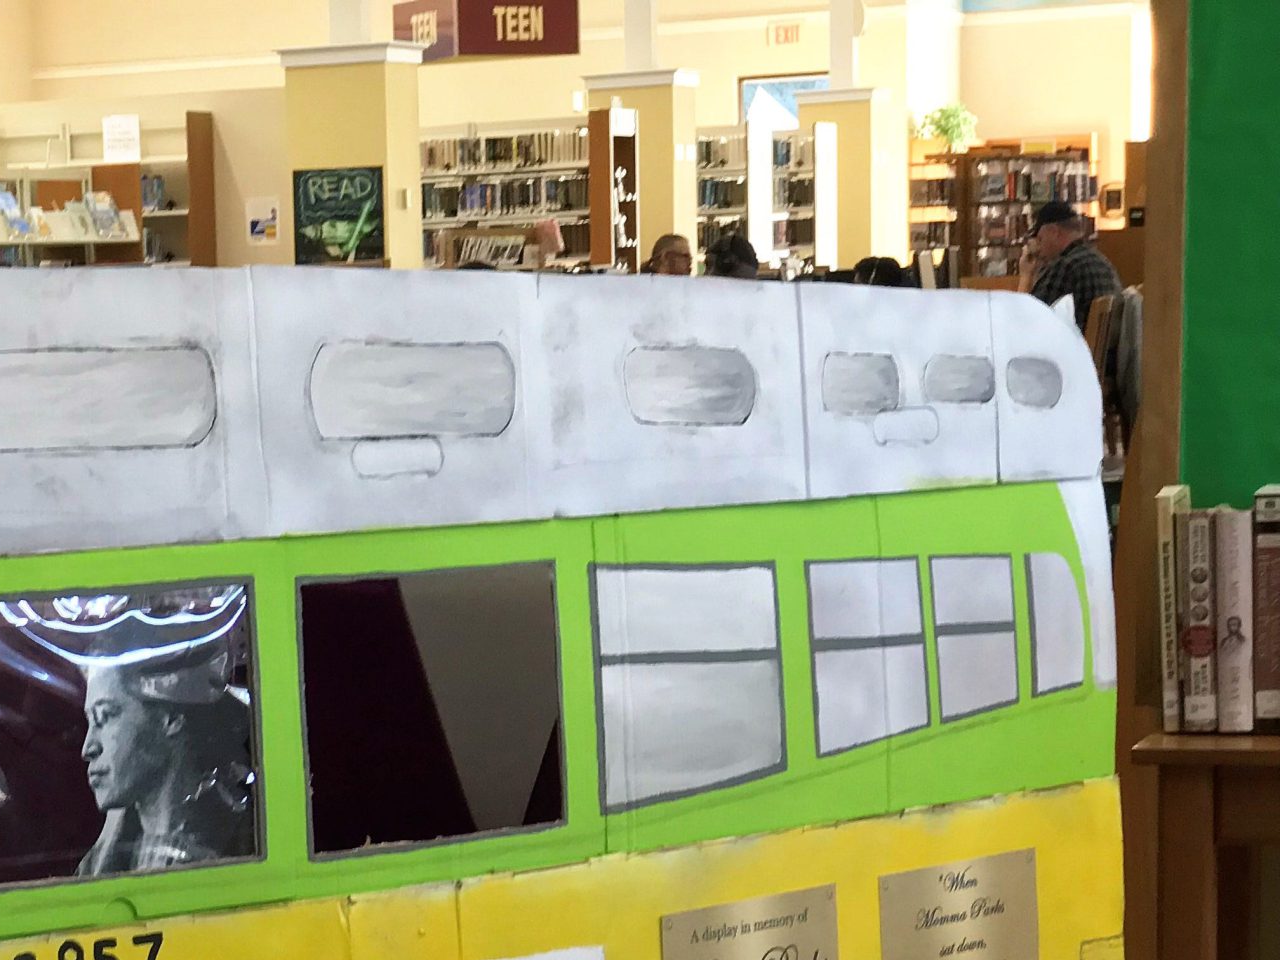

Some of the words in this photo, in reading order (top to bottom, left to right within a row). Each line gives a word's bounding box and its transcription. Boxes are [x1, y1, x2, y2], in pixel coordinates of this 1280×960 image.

[410, 10, 438, 44] TEEN
[492, 5, 544, 42] TEEN
[775, 24, 800, 46] EXIT
[308, 175, 372, 205] READ
[690, 930, 700, 944] A
[702, 922, 739, 944] display
[740, 919, 751, 935] in
[754, 913, 796, 933] memory
[797, 907, 809, 922] of
[915, 906, 968, 931] Momma
[970, 896, 1005, 919] Parks
[939, 941, 955, 957] sat
